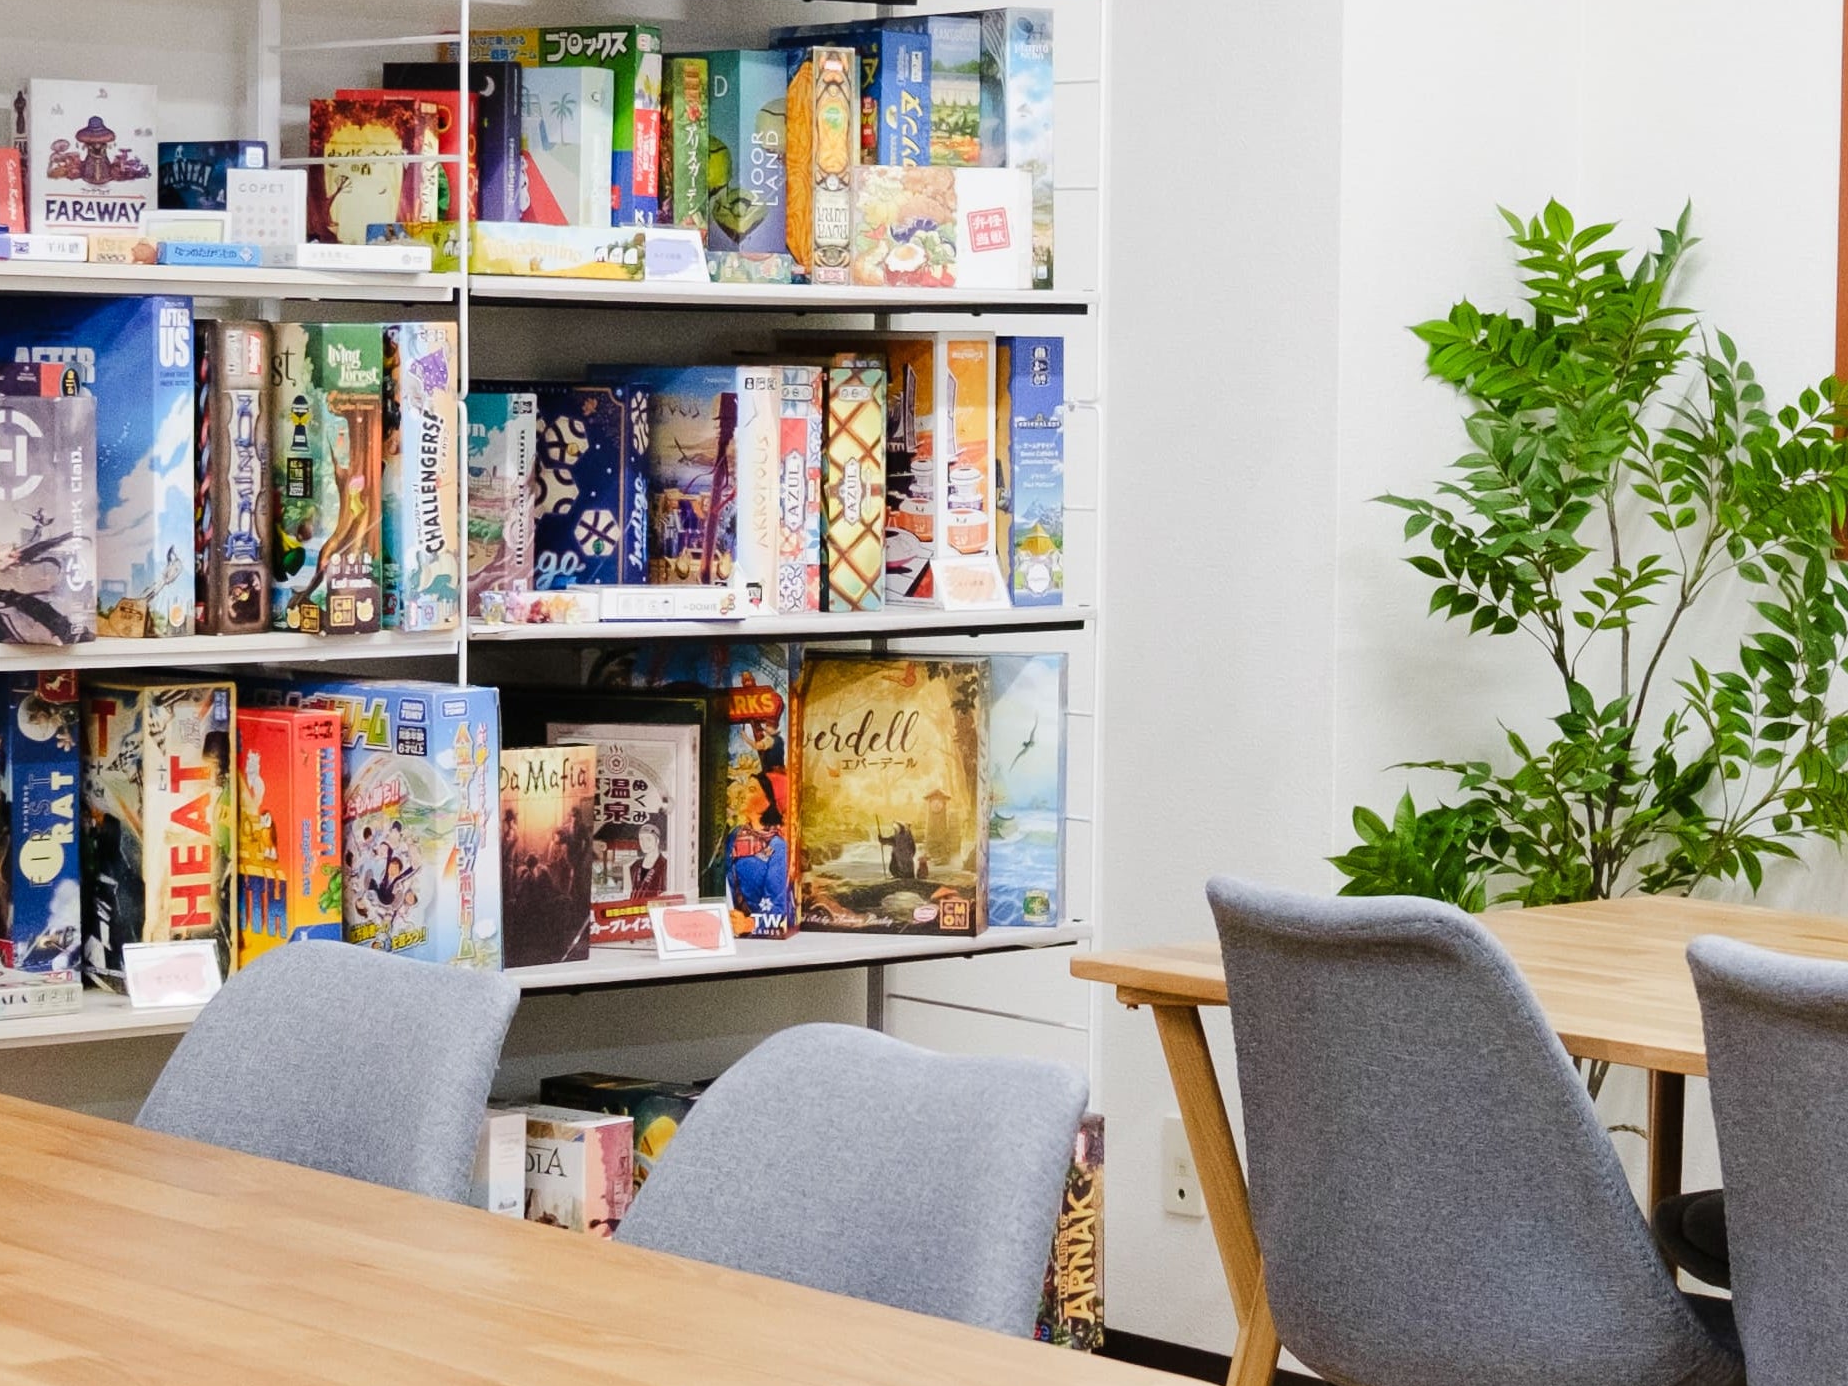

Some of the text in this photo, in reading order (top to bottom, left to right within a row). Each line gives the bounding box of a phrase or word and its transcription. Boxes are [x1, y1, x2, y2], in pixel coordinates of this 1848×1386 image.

[546, 31, 628, 63] ブロックス
[684, 123, 701, 221] アリスガーデン
[751, 131, 765, 207] MOOR
[766, 129, 779, 207] LAND
[45, 199, 146, 223] FARAWAY
[816, 223, 848, 239] NOVA
[159, 307, 190, 328] AFTER
[158, 327, 190, 367] US
[327, 343, 361, 370] living
[340, 363, 380, 384] forest
[226, 393, 260, 558] DOMINION
[420, 409, 445, 556] CHALLENGERS!
[755, 434, 770, 549] AKROPOLIS
[787, 467, 800, 517] AZUL
[846, 469, 857, 514] AZUL
[629, 473, 650, 570] Indigo
[537, 551, 585, 590] go
[524, 758, 588, 795] Mafia
[603, 777, 632, 823] 温泉
[632, 778, 650, 823] ぬくみ
[51, 771, 74, 844] RAT
[319, 747, 336, 857] LABYRINTH
[31, 772, 52, 888] FIRST
[169, 756, 212, 929] HEAT
[753, 912, 783, 928] TW
[1064, 1179, 1097, 1324] ARNAK
